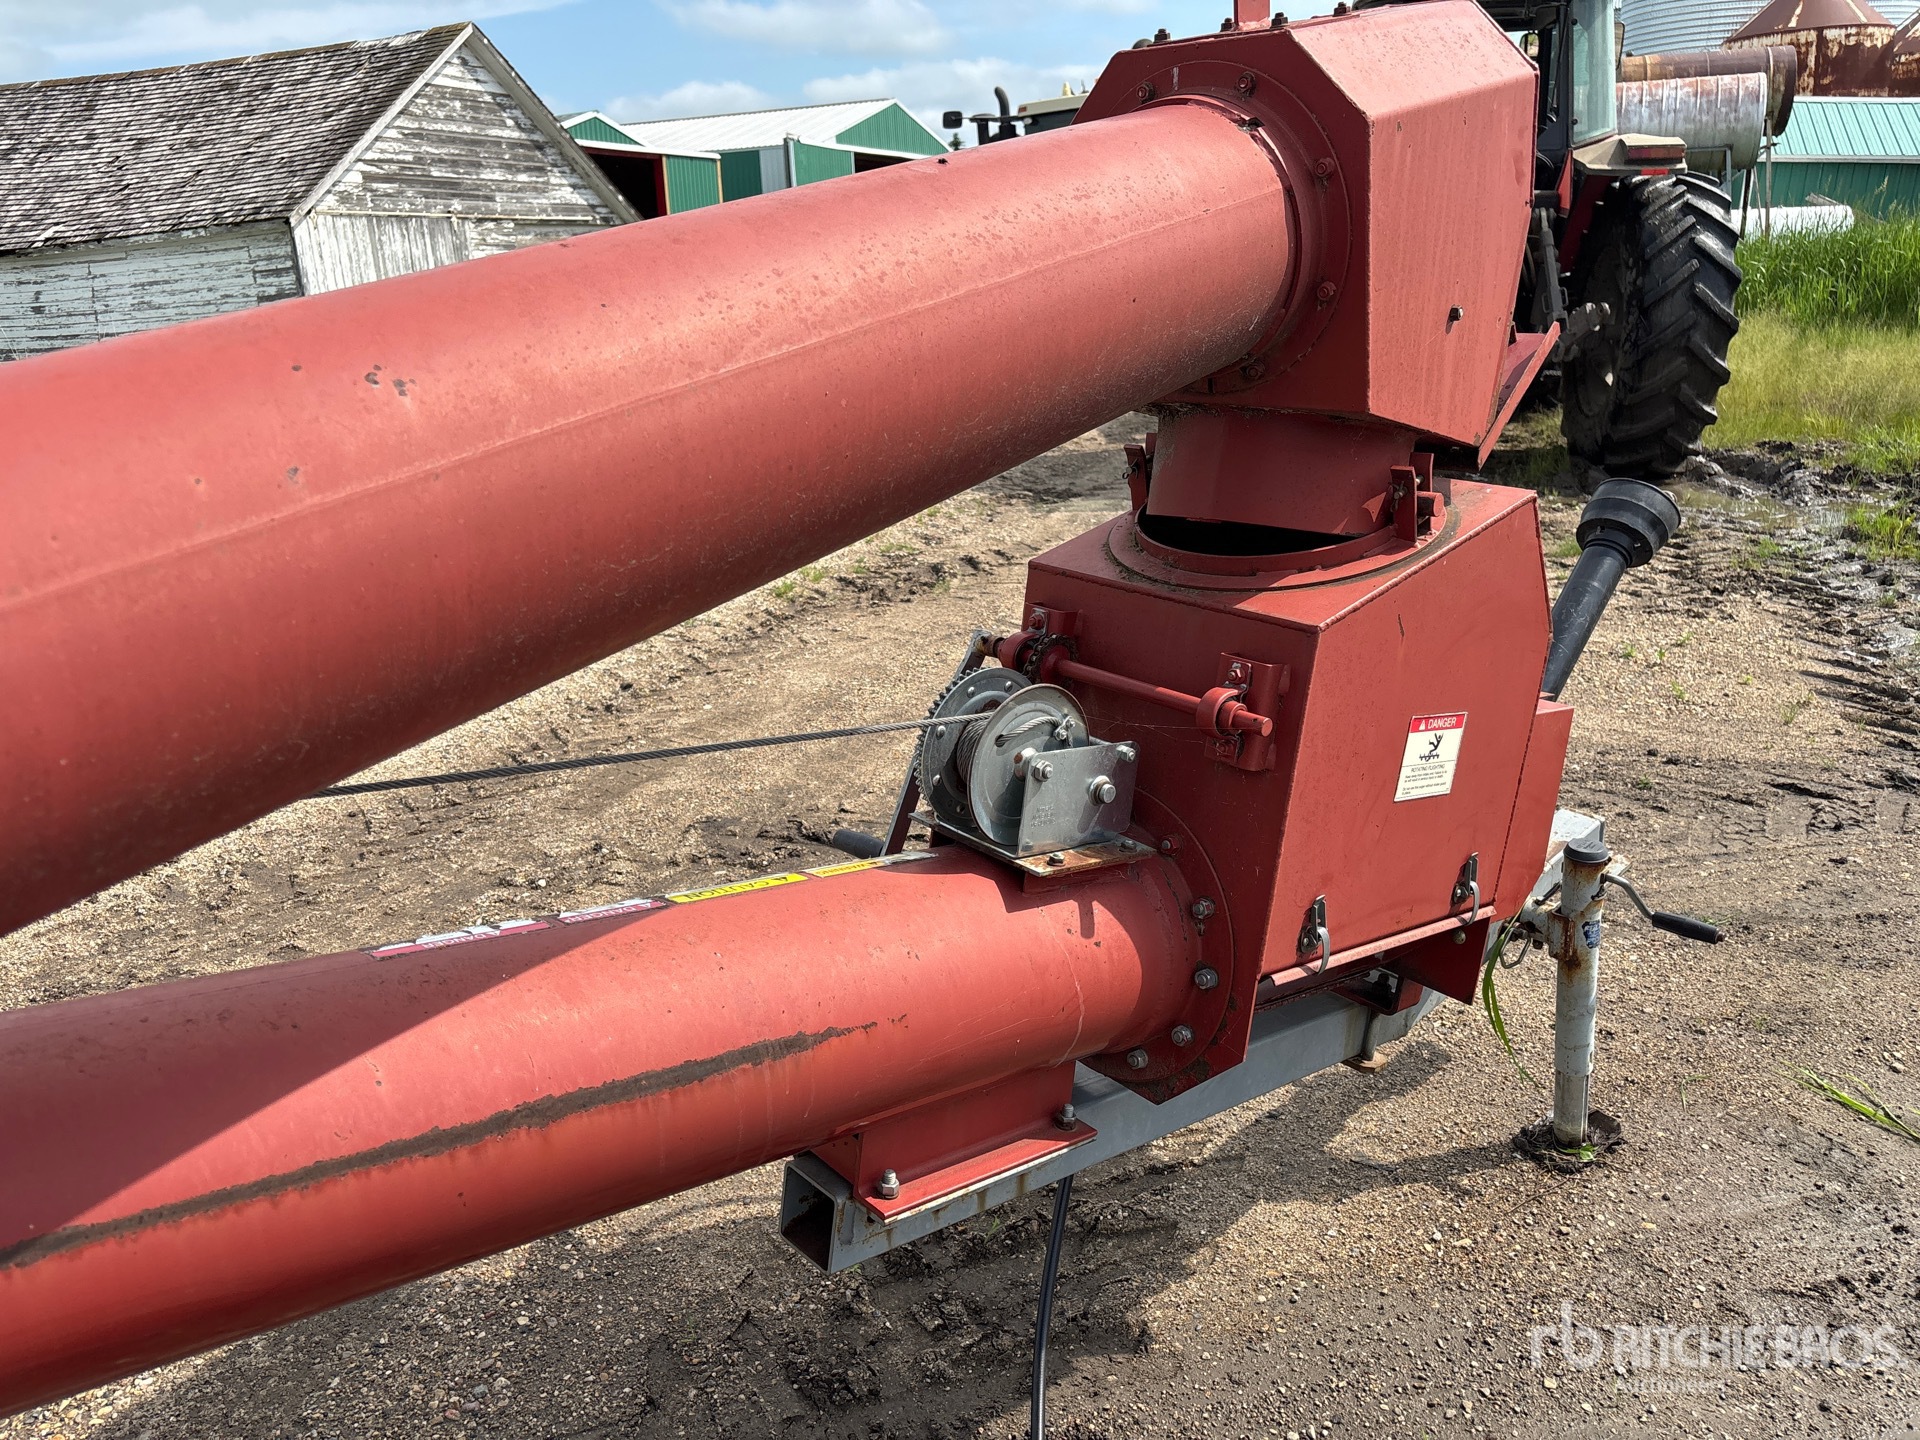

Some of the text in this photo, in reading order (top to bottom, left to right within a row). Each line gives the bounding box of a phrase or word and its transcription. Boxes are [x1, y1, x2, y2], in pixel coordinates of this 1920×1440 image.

[1428, 717, 1457, 729] DANGER
[684, 881, 770, 900] CAUTION
[573, 906, 636, 921] DANGER
[421, 933, 487, 949] DANGER
